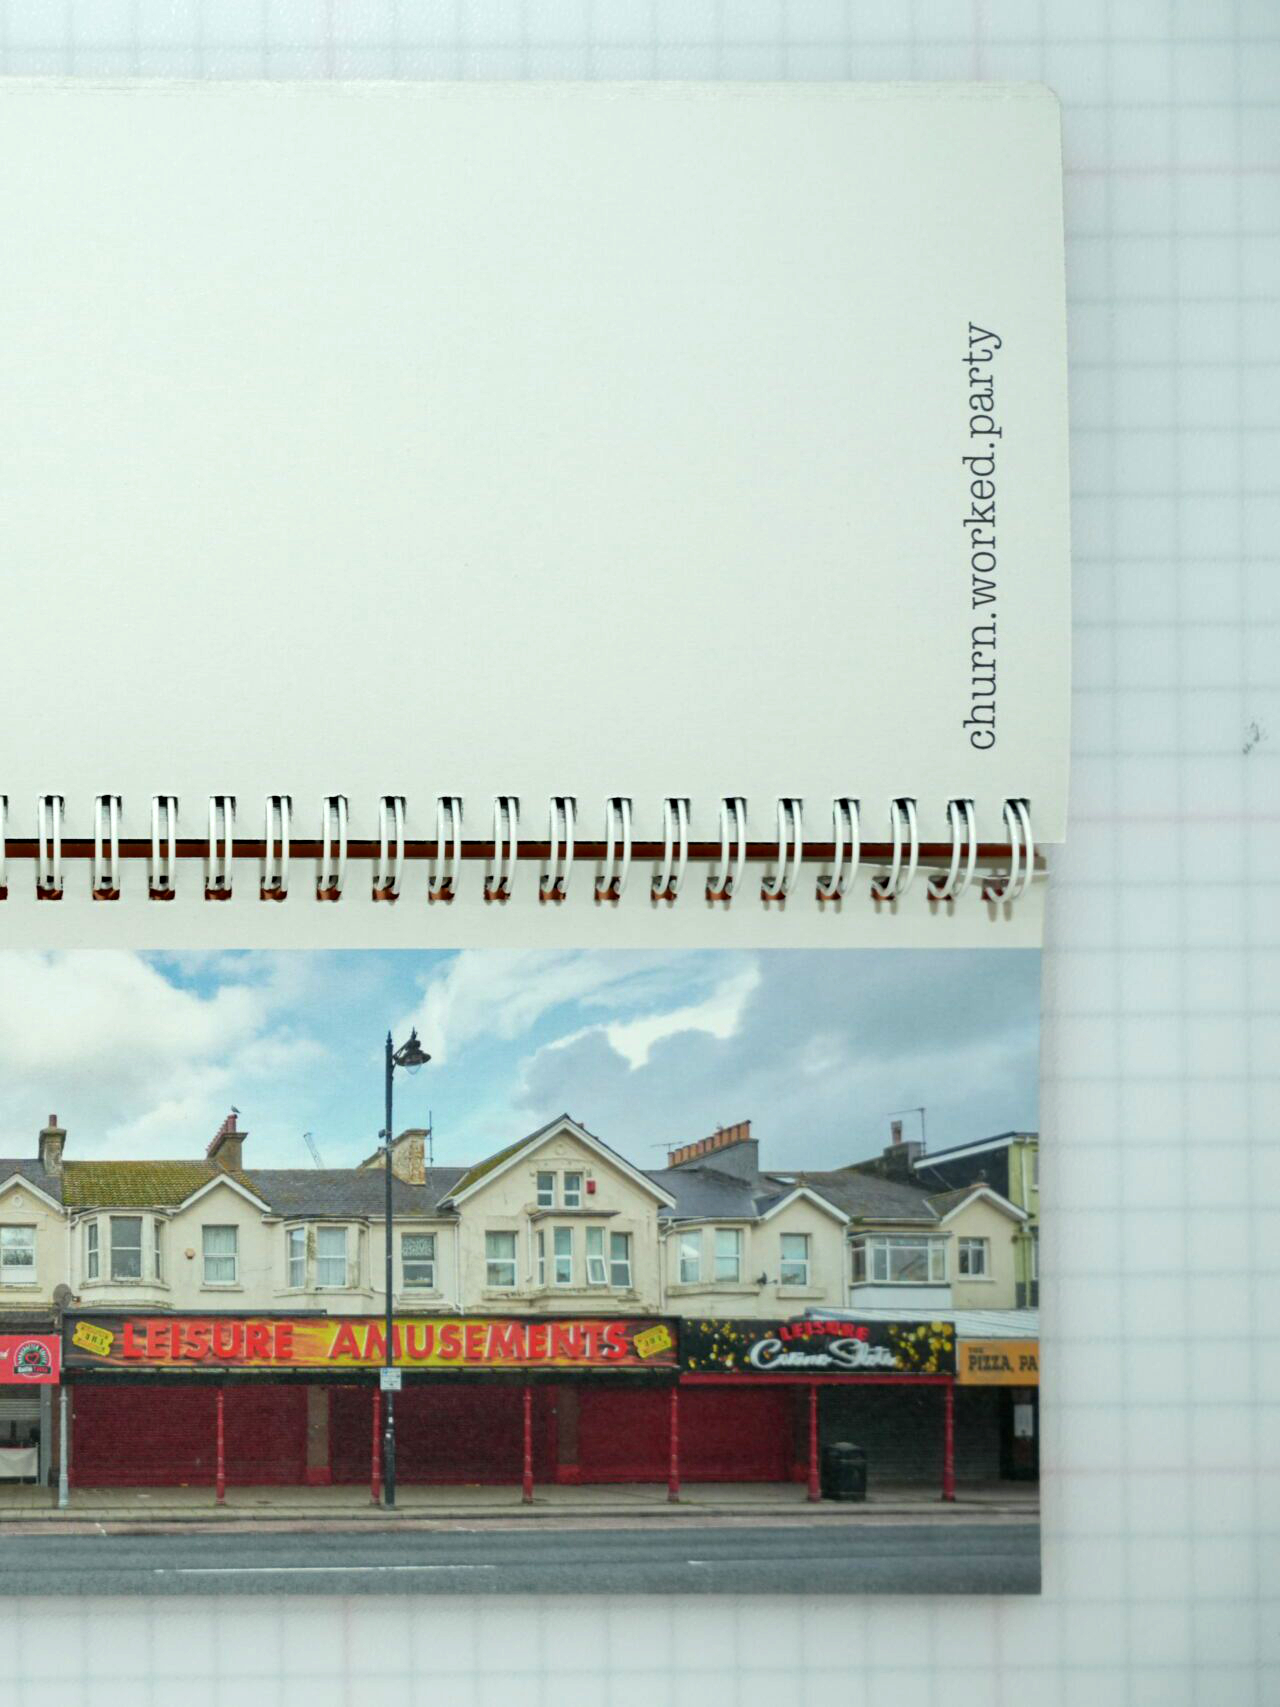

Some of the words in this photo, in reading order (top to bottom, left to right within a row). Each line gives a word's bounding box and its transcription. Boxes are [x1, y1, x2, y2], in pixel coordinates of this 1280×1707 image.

[962, 321, 1003, 750] churn.worked.party
[122, 1322, 294, 1358] LEISURE
[327, 1324, 629, 1359] AMUSEMENTS
[779, 1321, 869, 1341] LEISURE
